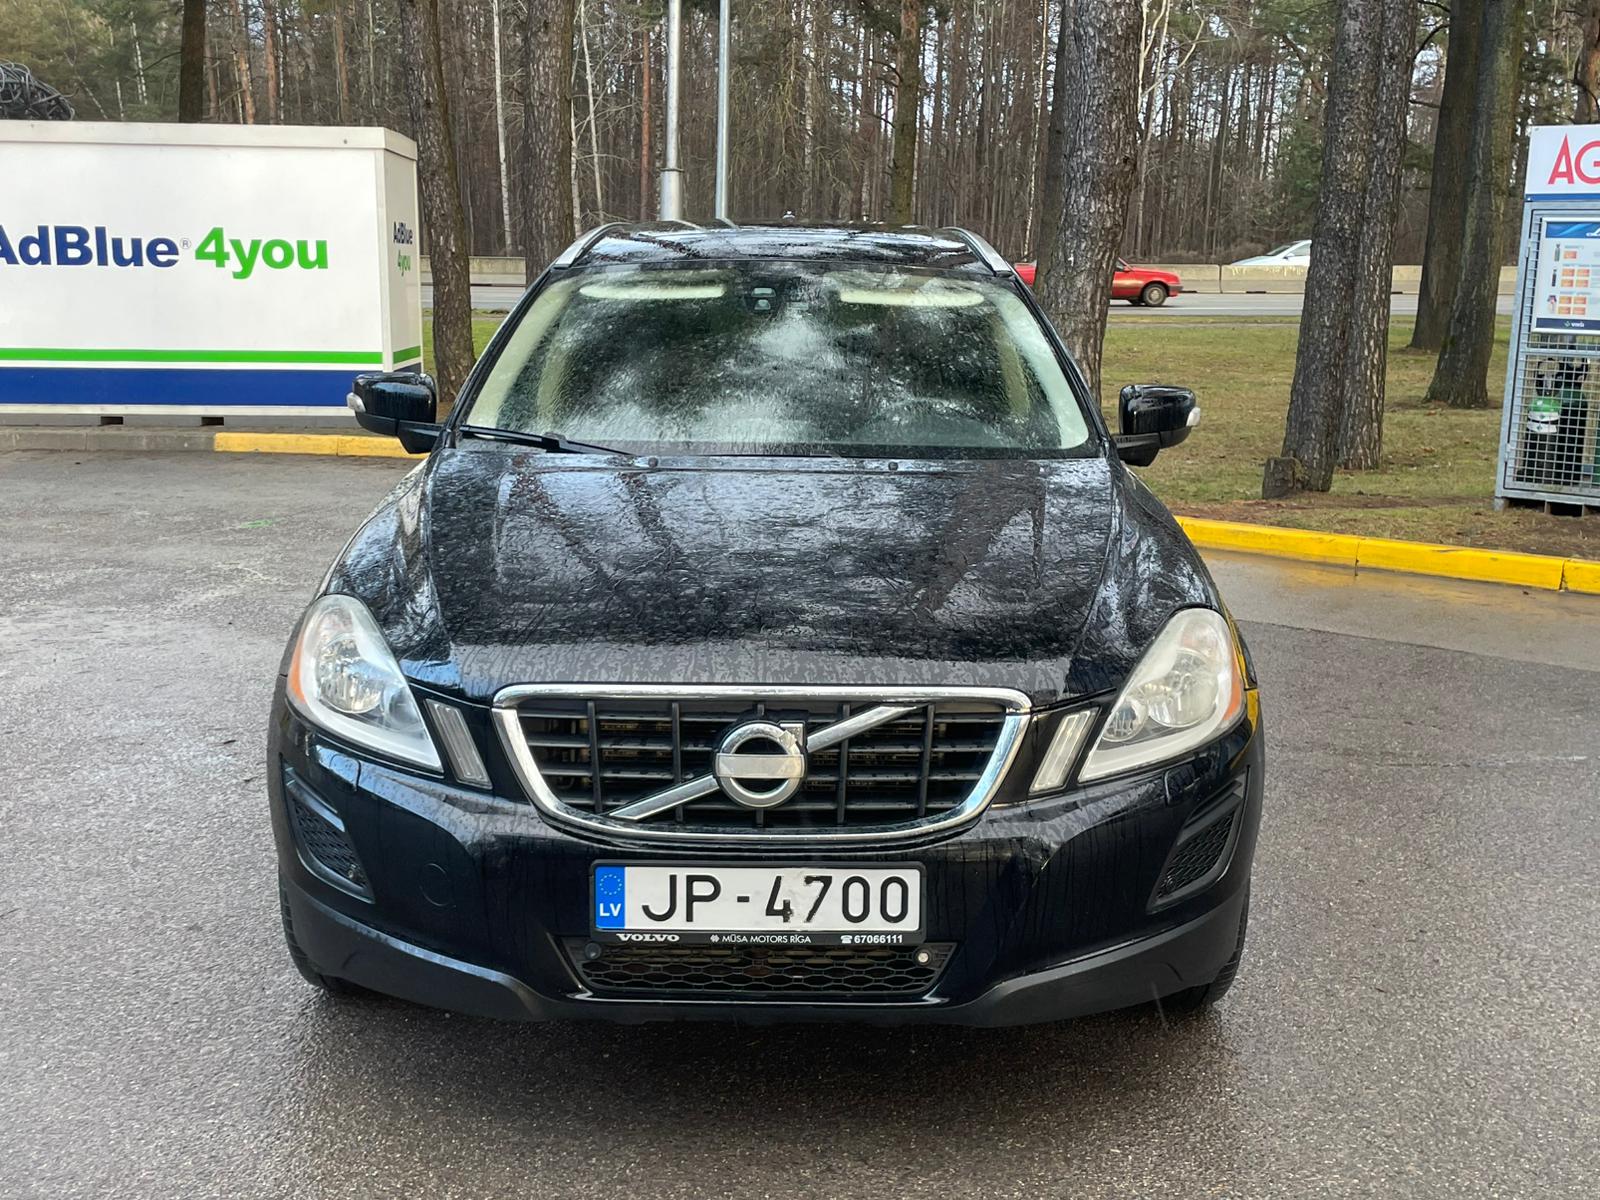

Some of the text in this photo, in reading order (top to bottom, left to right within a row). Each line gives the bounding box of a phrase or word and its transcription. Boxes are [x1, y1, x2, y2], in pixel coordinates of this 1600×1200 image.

[393, 221, 413, 245] AdBlue
[195, 227, 328, 280] 4you
[599, 903, 622, 917] LV
[616, 933, 680, 942] VOLVO
[750, 935, 788, 943] MOTORS
[854, 934, 903, 944] 67066111
